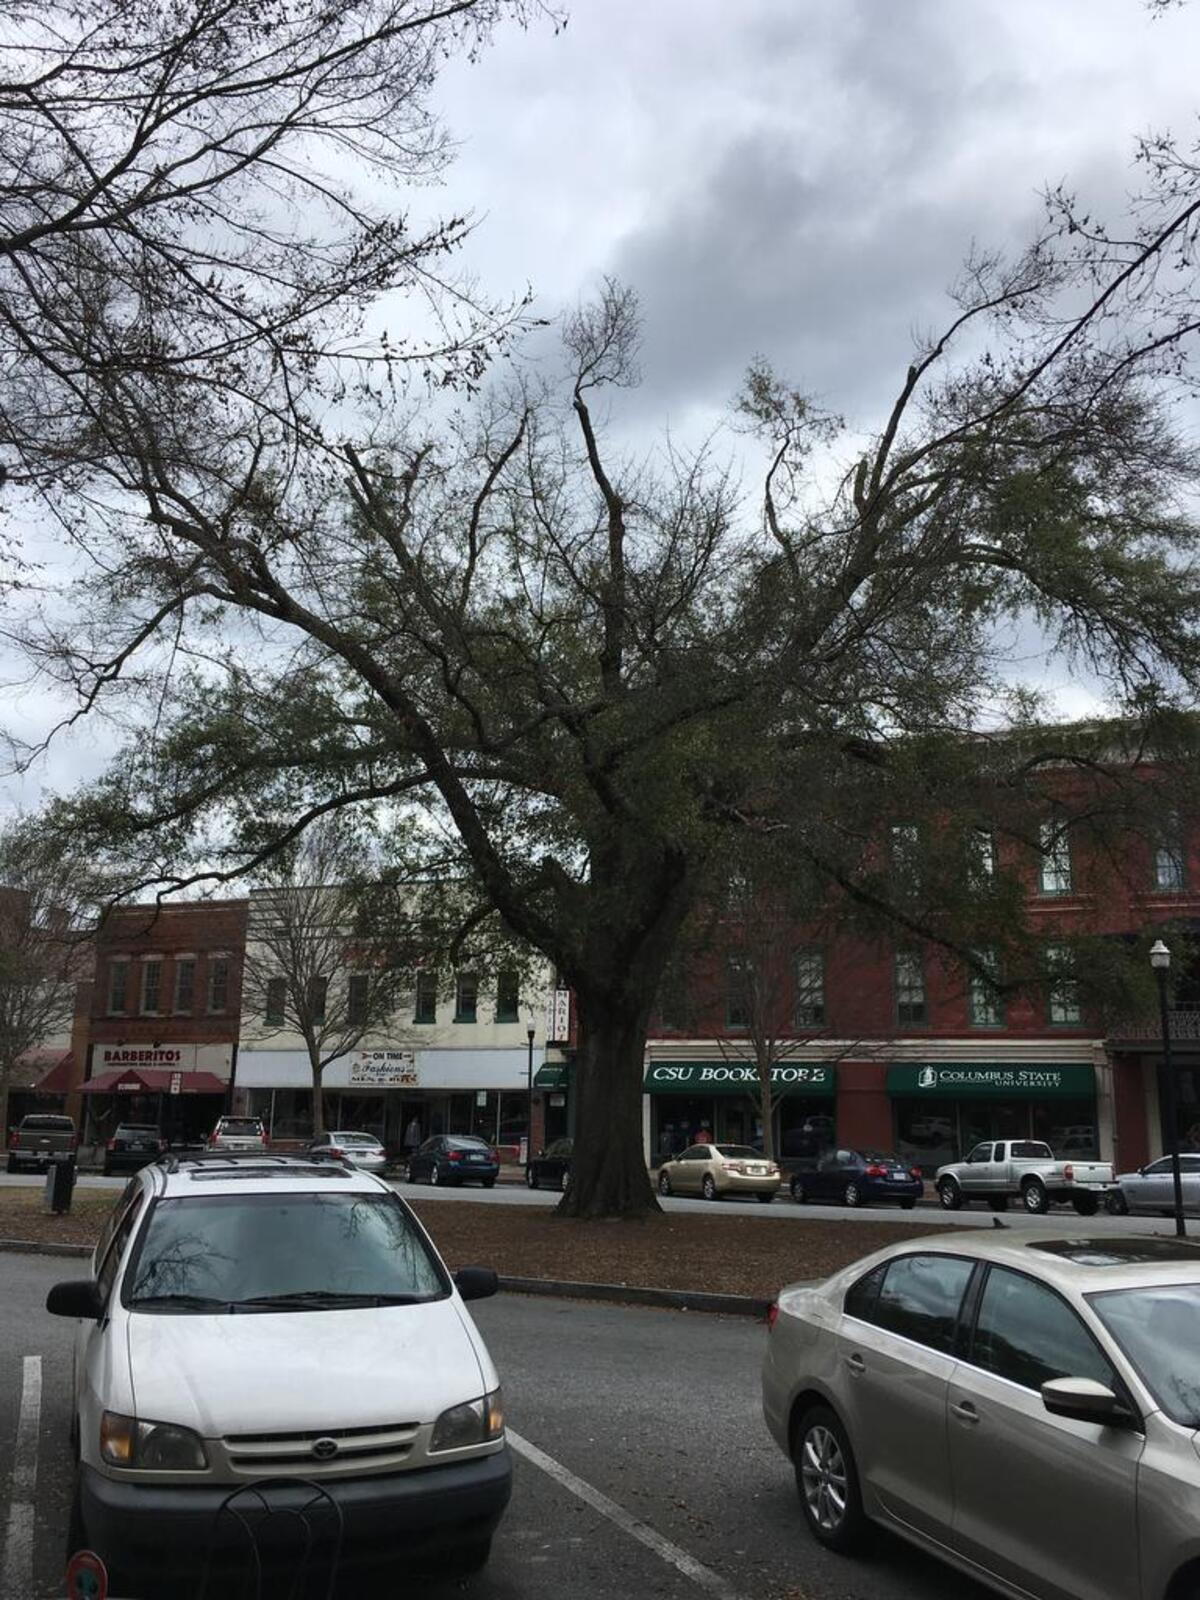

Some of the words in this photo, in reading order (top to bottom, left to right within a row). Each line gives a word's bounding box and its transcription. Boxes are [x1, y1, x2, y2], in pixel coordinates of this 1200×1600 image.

[104, 1050, 181, 1062] BARBERITOS
[373, 1052, 385, 1060] ON
[387, 1052, 403, 1060] TIME
[652, 1067, 694, 1081] CSU
[699, 1067, 826, 1082] BOOKTORE
[939, 1070, 1014, 1081] COLUMBUS
[1018, 1070, 1061, 1081] STATE
